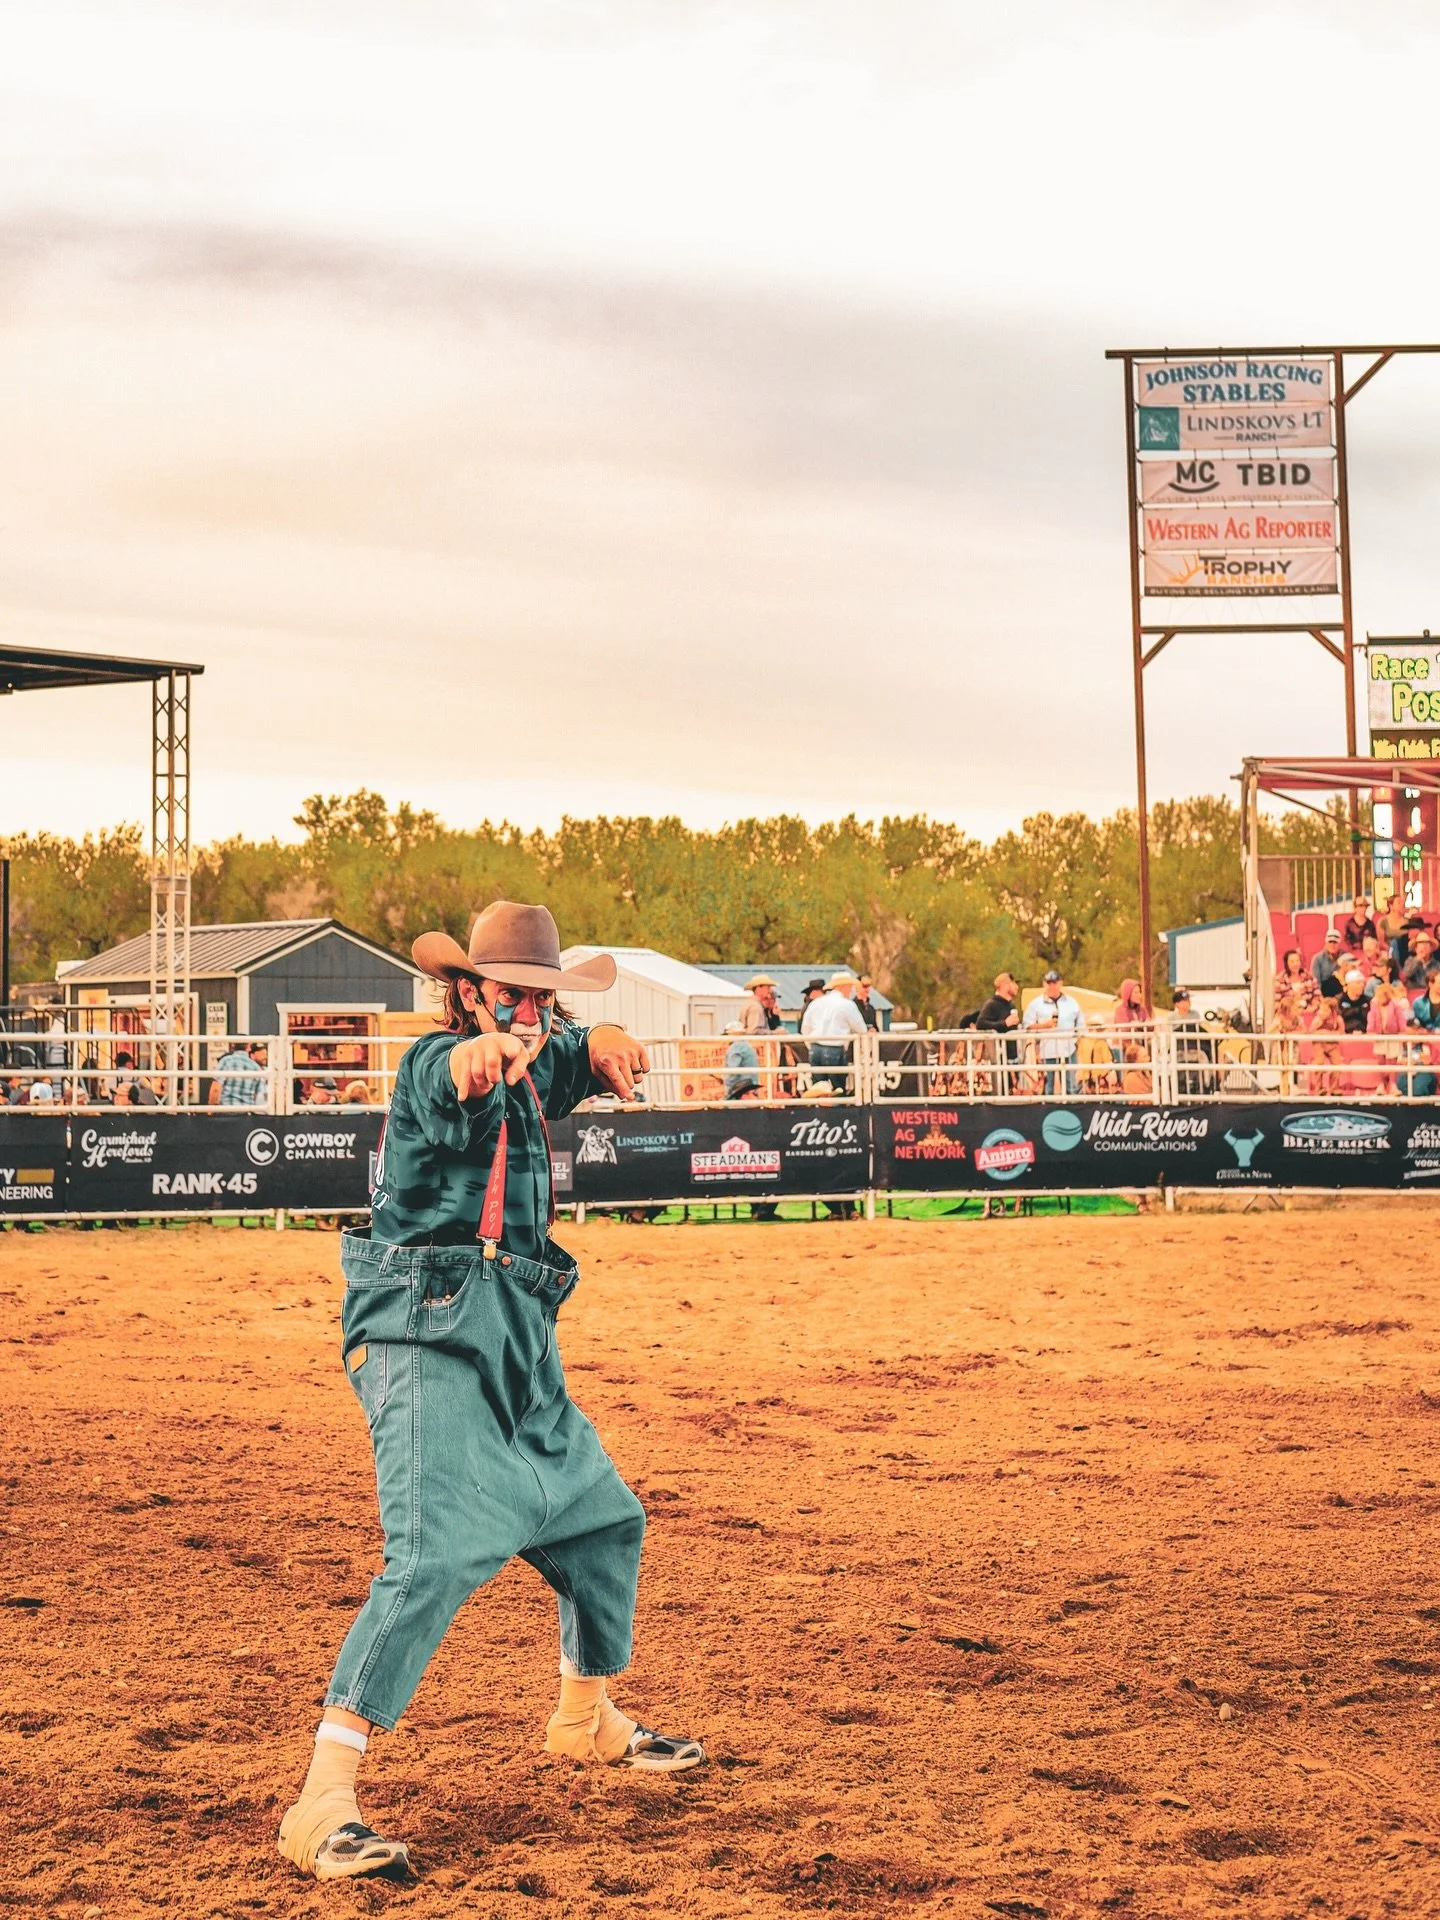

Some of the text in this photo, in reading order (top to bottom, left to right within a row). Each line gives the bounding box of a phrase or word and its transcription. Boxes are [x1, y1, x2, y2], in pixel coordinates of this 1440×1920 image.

[1146, 362, 1323, 390] JOHNSON RACING
[1183, 383, 1285, 402] STABLES
[1303, 411, 1324, 428] LT
[1236, 432, 1276, 442] RANCH
[1176, 461, 1311, 486] MC TBID
[1147, 516, 1332, 541] WESTERN AG REPORTER
[1199, 556, 1292, 575] TROPHY
[1371, 653, 1429, 680] Race
[1392, 682, 1440, 722] Pos
[891, 1110, 958, 1125] WESTERN
[1083, 1110, 1208, 1141] Mid-Rivers
[81, 1129, 157, 1152] Carmichael
[283, 1133, 356, 1148] COWBOY
[680, 1132, 694, 1145] LT
[790, 1118, 857, 1146] Tito's
[895, 1128, 915, 1142] AG
[1093, 1140, 1197, 1152] COMMUNICATIONS
[1283, 1134, 1391, 1149] BLUE ROCK
[82, 1144, 153, 1168] Herefords
[285, 1148, 355, 1160] CHANNEL
[694, 1154, 778, 1166] STEADMAN'S
[894, 1145, 966, 1159] NETWORK
[979, 1147, 1031, 1165] Anipro
